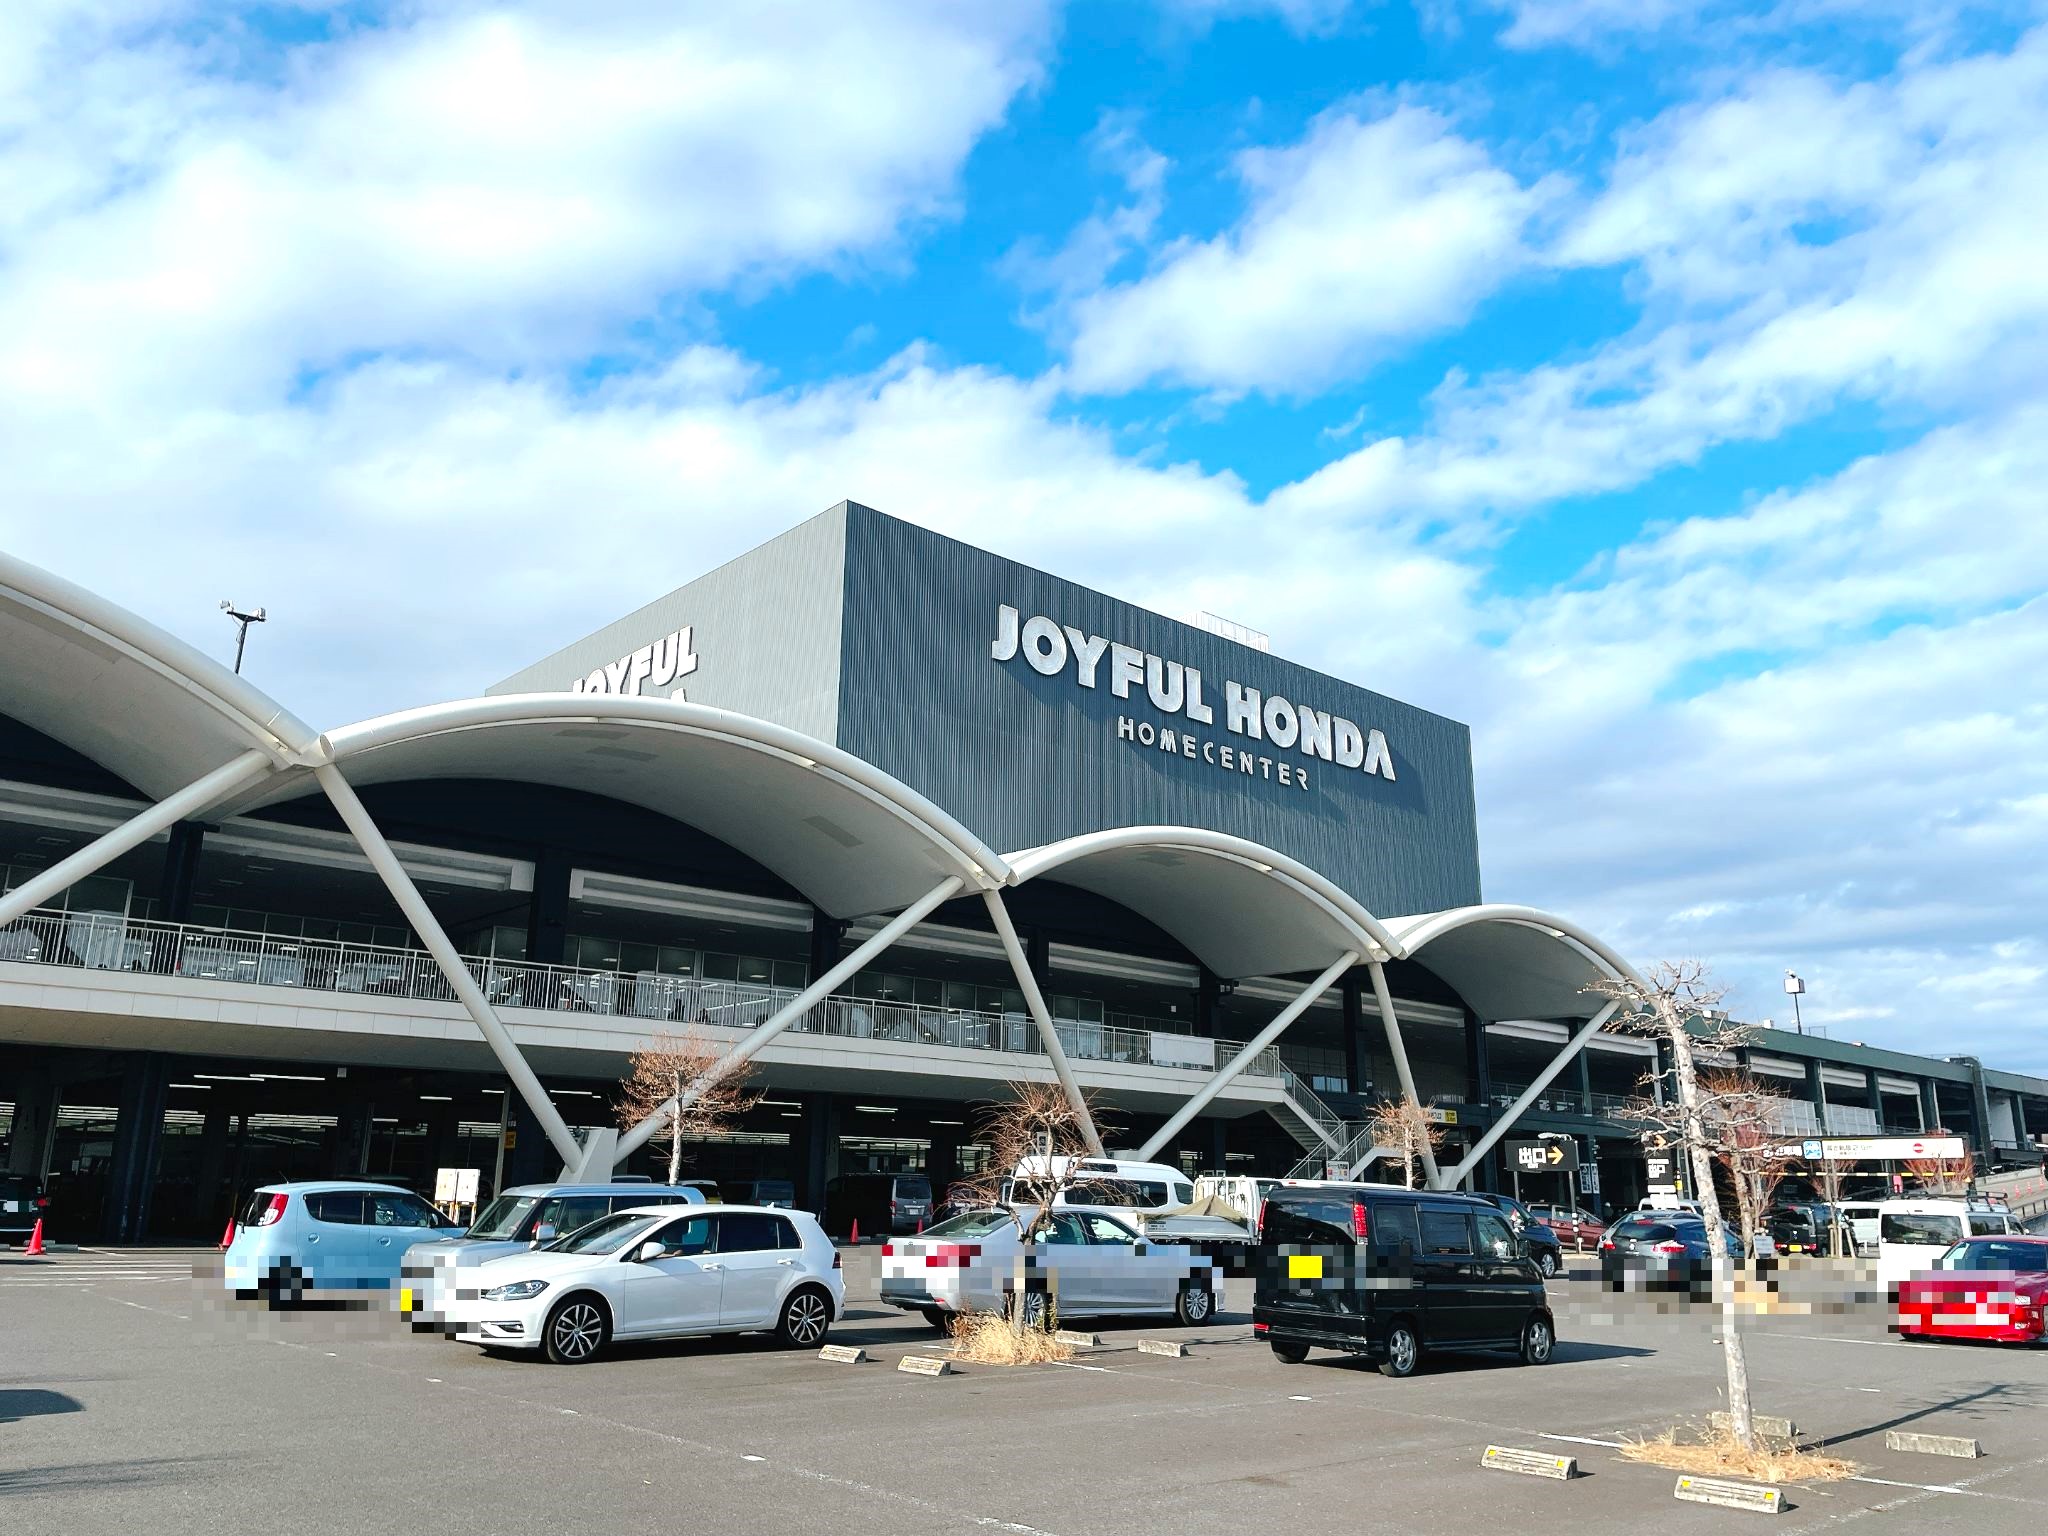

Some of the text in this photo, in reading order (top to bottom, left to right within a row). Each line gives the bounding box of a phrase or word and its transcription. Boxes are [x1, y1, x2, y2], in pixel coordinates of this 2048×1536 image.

[991, 604, 1397, 782] JOYFUL HONDA
[1117, 715, 1309, 791] HOMECENTER
[1518, 1147, 1547, 1164] 出口
